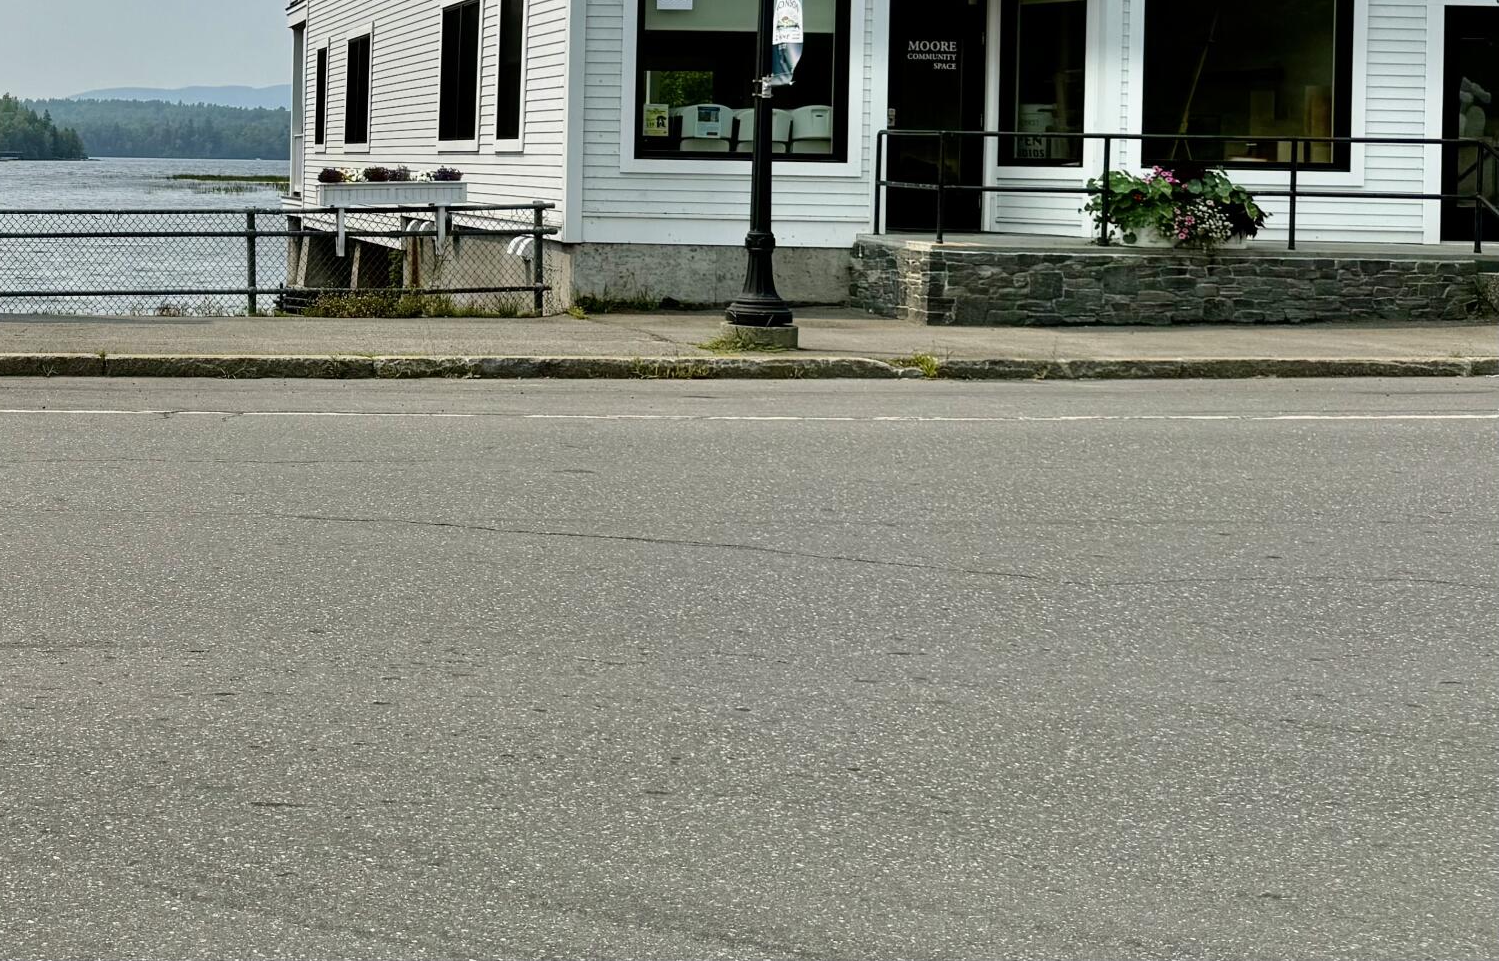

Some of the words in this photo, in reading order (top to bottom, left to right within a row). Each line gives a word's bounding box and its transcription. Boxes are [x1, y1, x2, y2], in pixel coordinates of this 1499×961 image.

[908, 40, 957, 51] MOORE
[907, 53, 957, 61] COMMUNITY
[933, 62, 957, 70] SPACE
